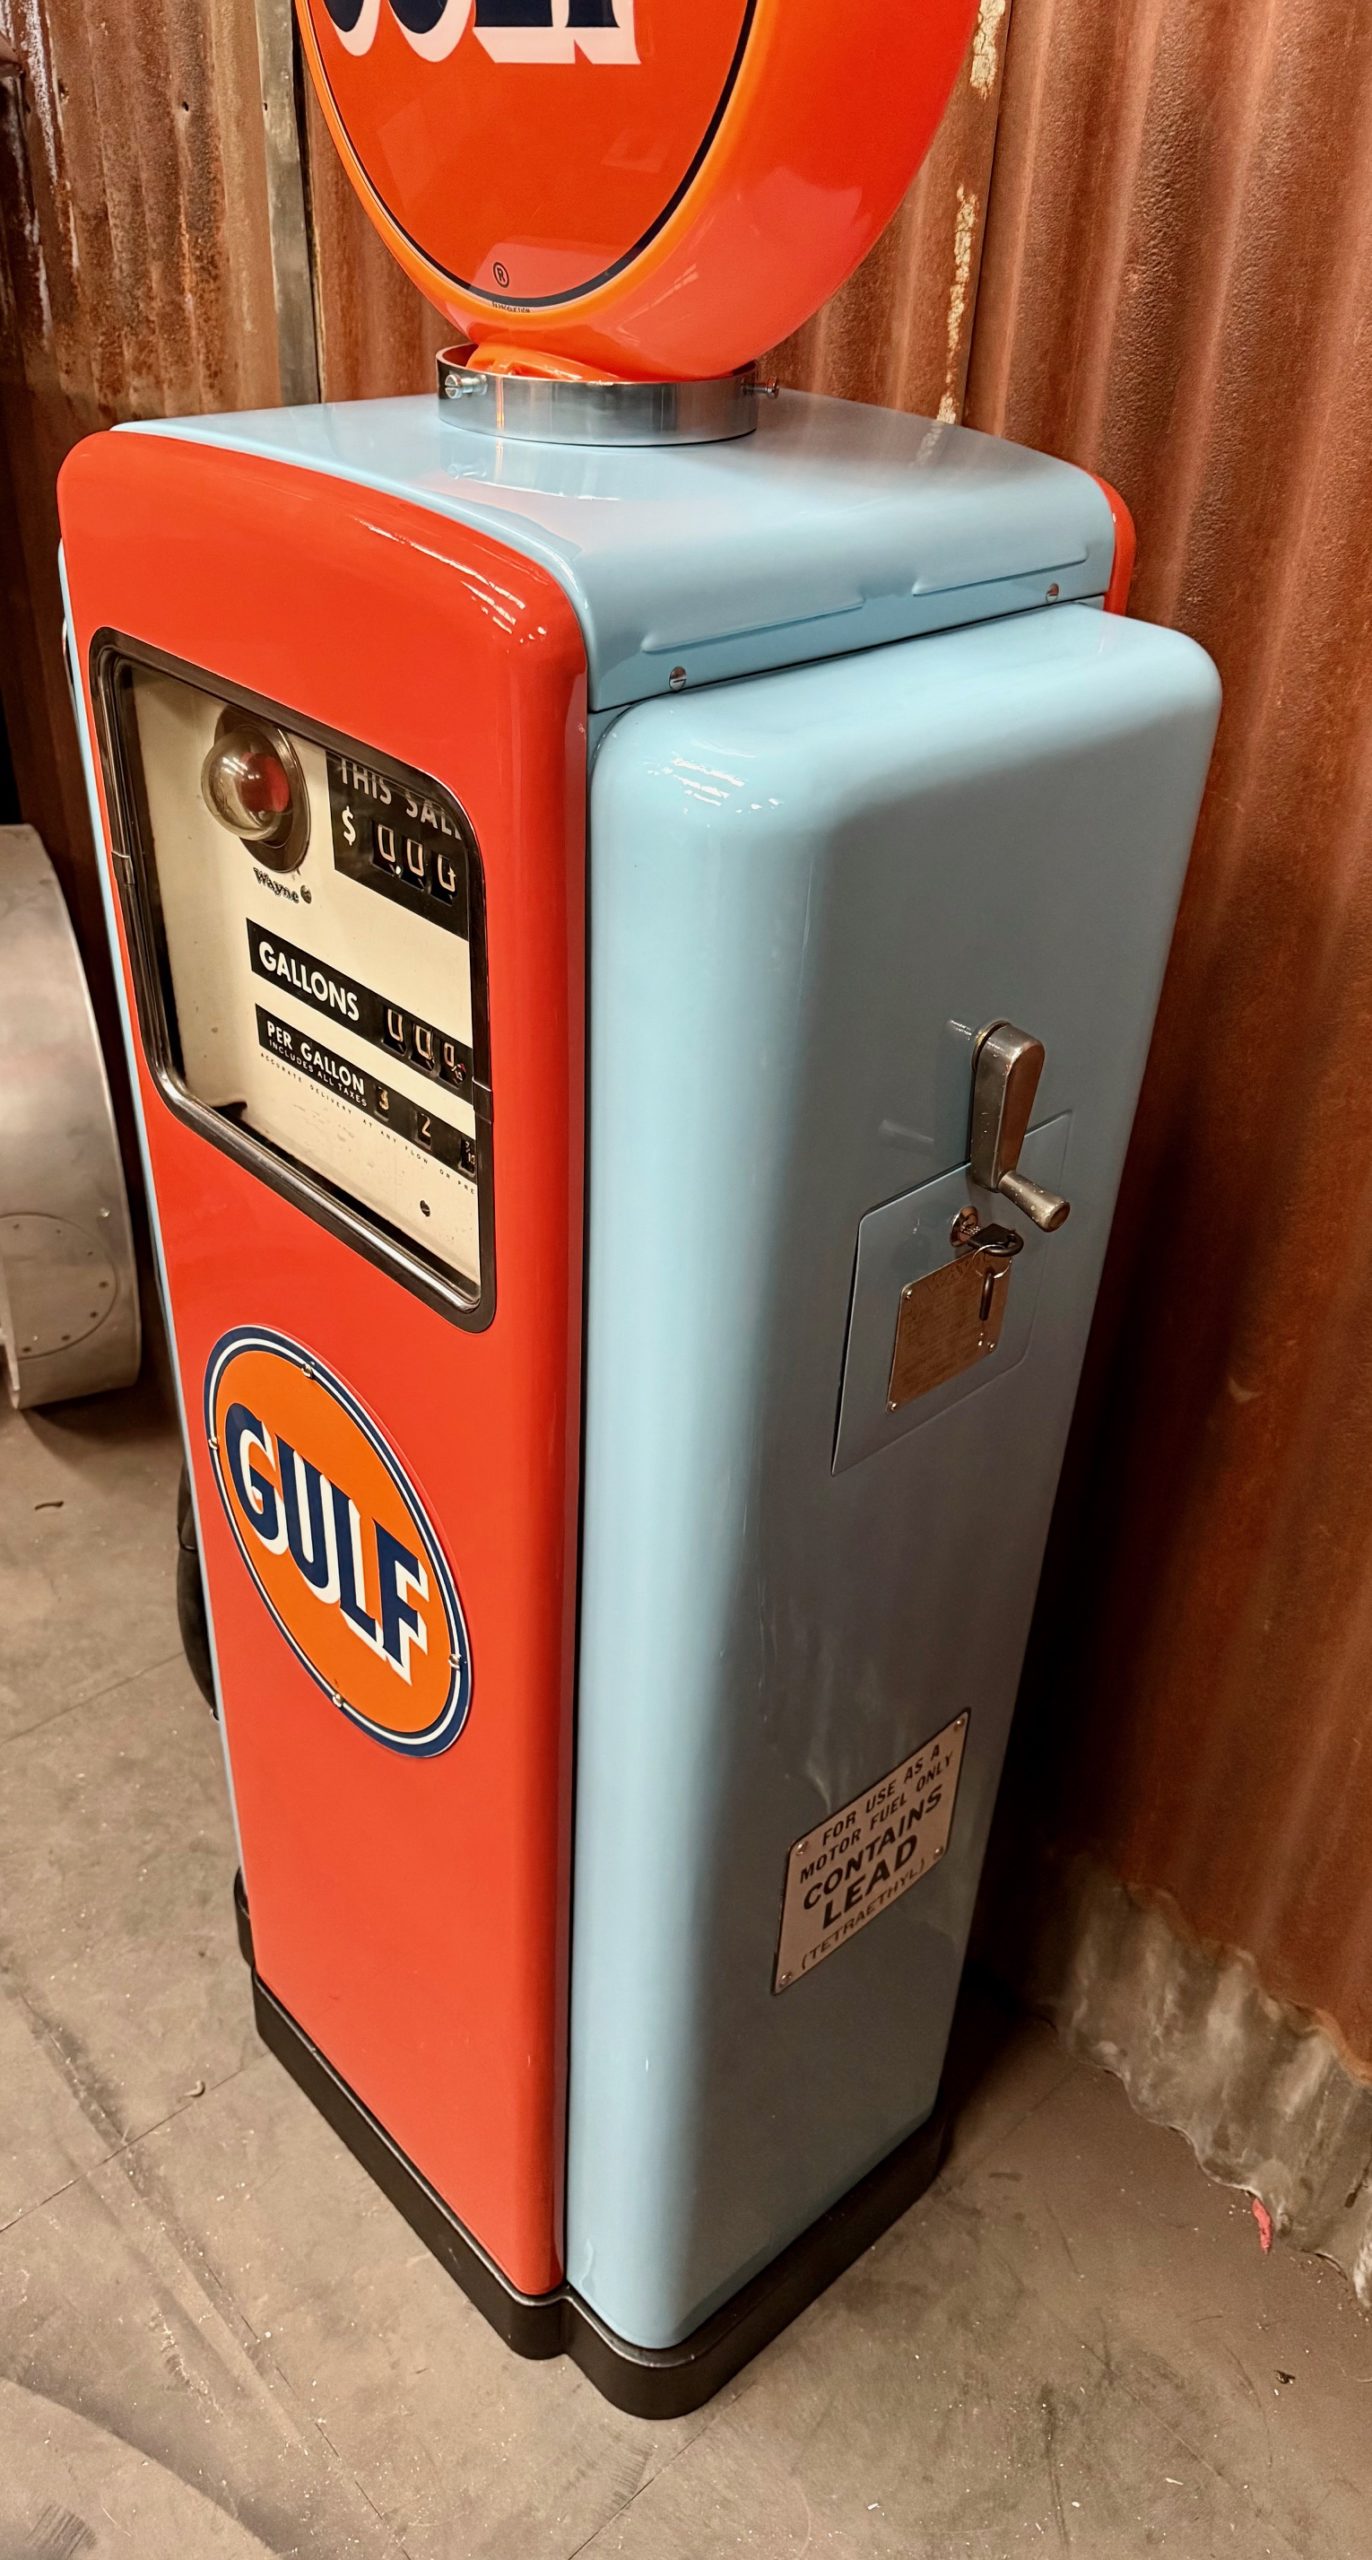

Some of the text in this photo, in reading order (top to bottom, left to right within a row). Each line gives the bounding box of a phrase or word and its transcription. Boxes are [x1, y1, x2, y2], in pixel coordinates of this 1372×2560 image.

[341, 758, 392, 805] THIS
[341, 805, 356, 846] $
[253, 866, 299, 904] Wayne
[258, 941, 360, 1021] GALLONS
[266, 1020, 293, 1051] PER
[300, 1042, 365, 1096] GALLON
[269, 1039, 367, 1107] INCLUDES ALL TAXES
[224, 1402, 430, 1686] GULF
[800, 1751, 953, 1883] MOTOR FUEL ONLY
[822, 1743, 940, 1846] FOR USE AS A
[803, 1784, 943, 1910] CONTAINS
[822, 1834, 918, 1930] LEAD
[801, 1858, 926, 1970] (TETRAETHYL)
